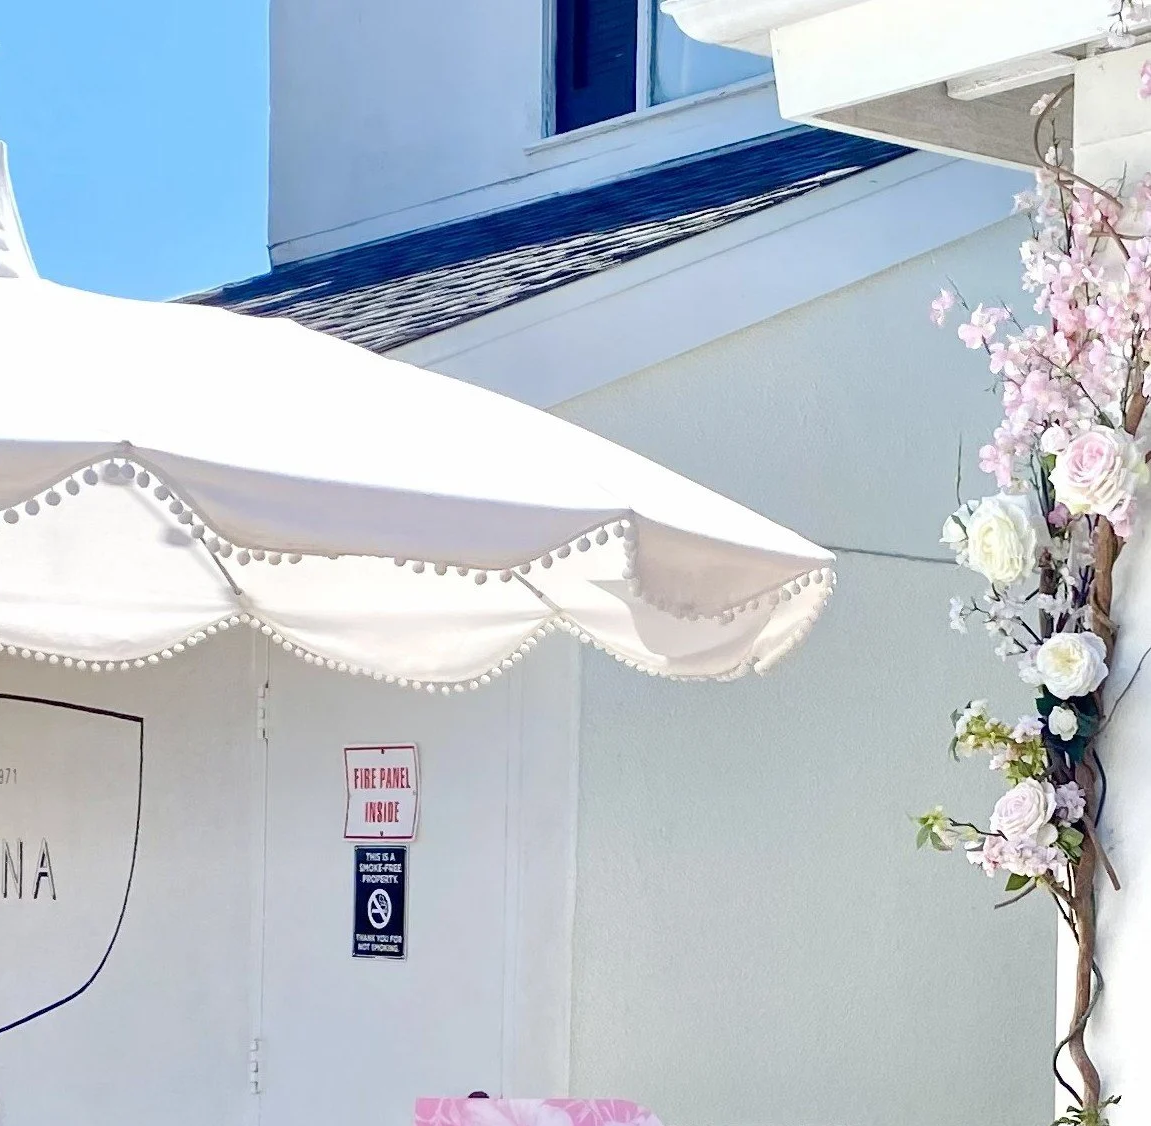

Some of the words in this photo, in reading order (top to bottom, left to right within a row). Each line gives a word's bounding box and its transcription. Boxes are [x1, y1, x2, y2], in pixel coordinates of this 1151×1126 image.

[353, 767, 376, 790] FIRE
[380, 767, 411, 789] PANEL
[365, 801, 400, 823] INSIDE
[365, 852, 380, 861] THIS
[382, 852, 389, 861] IS
[390, 852, 396, 861] A
[359, 863, 402, 873] SMOKE-FREE
